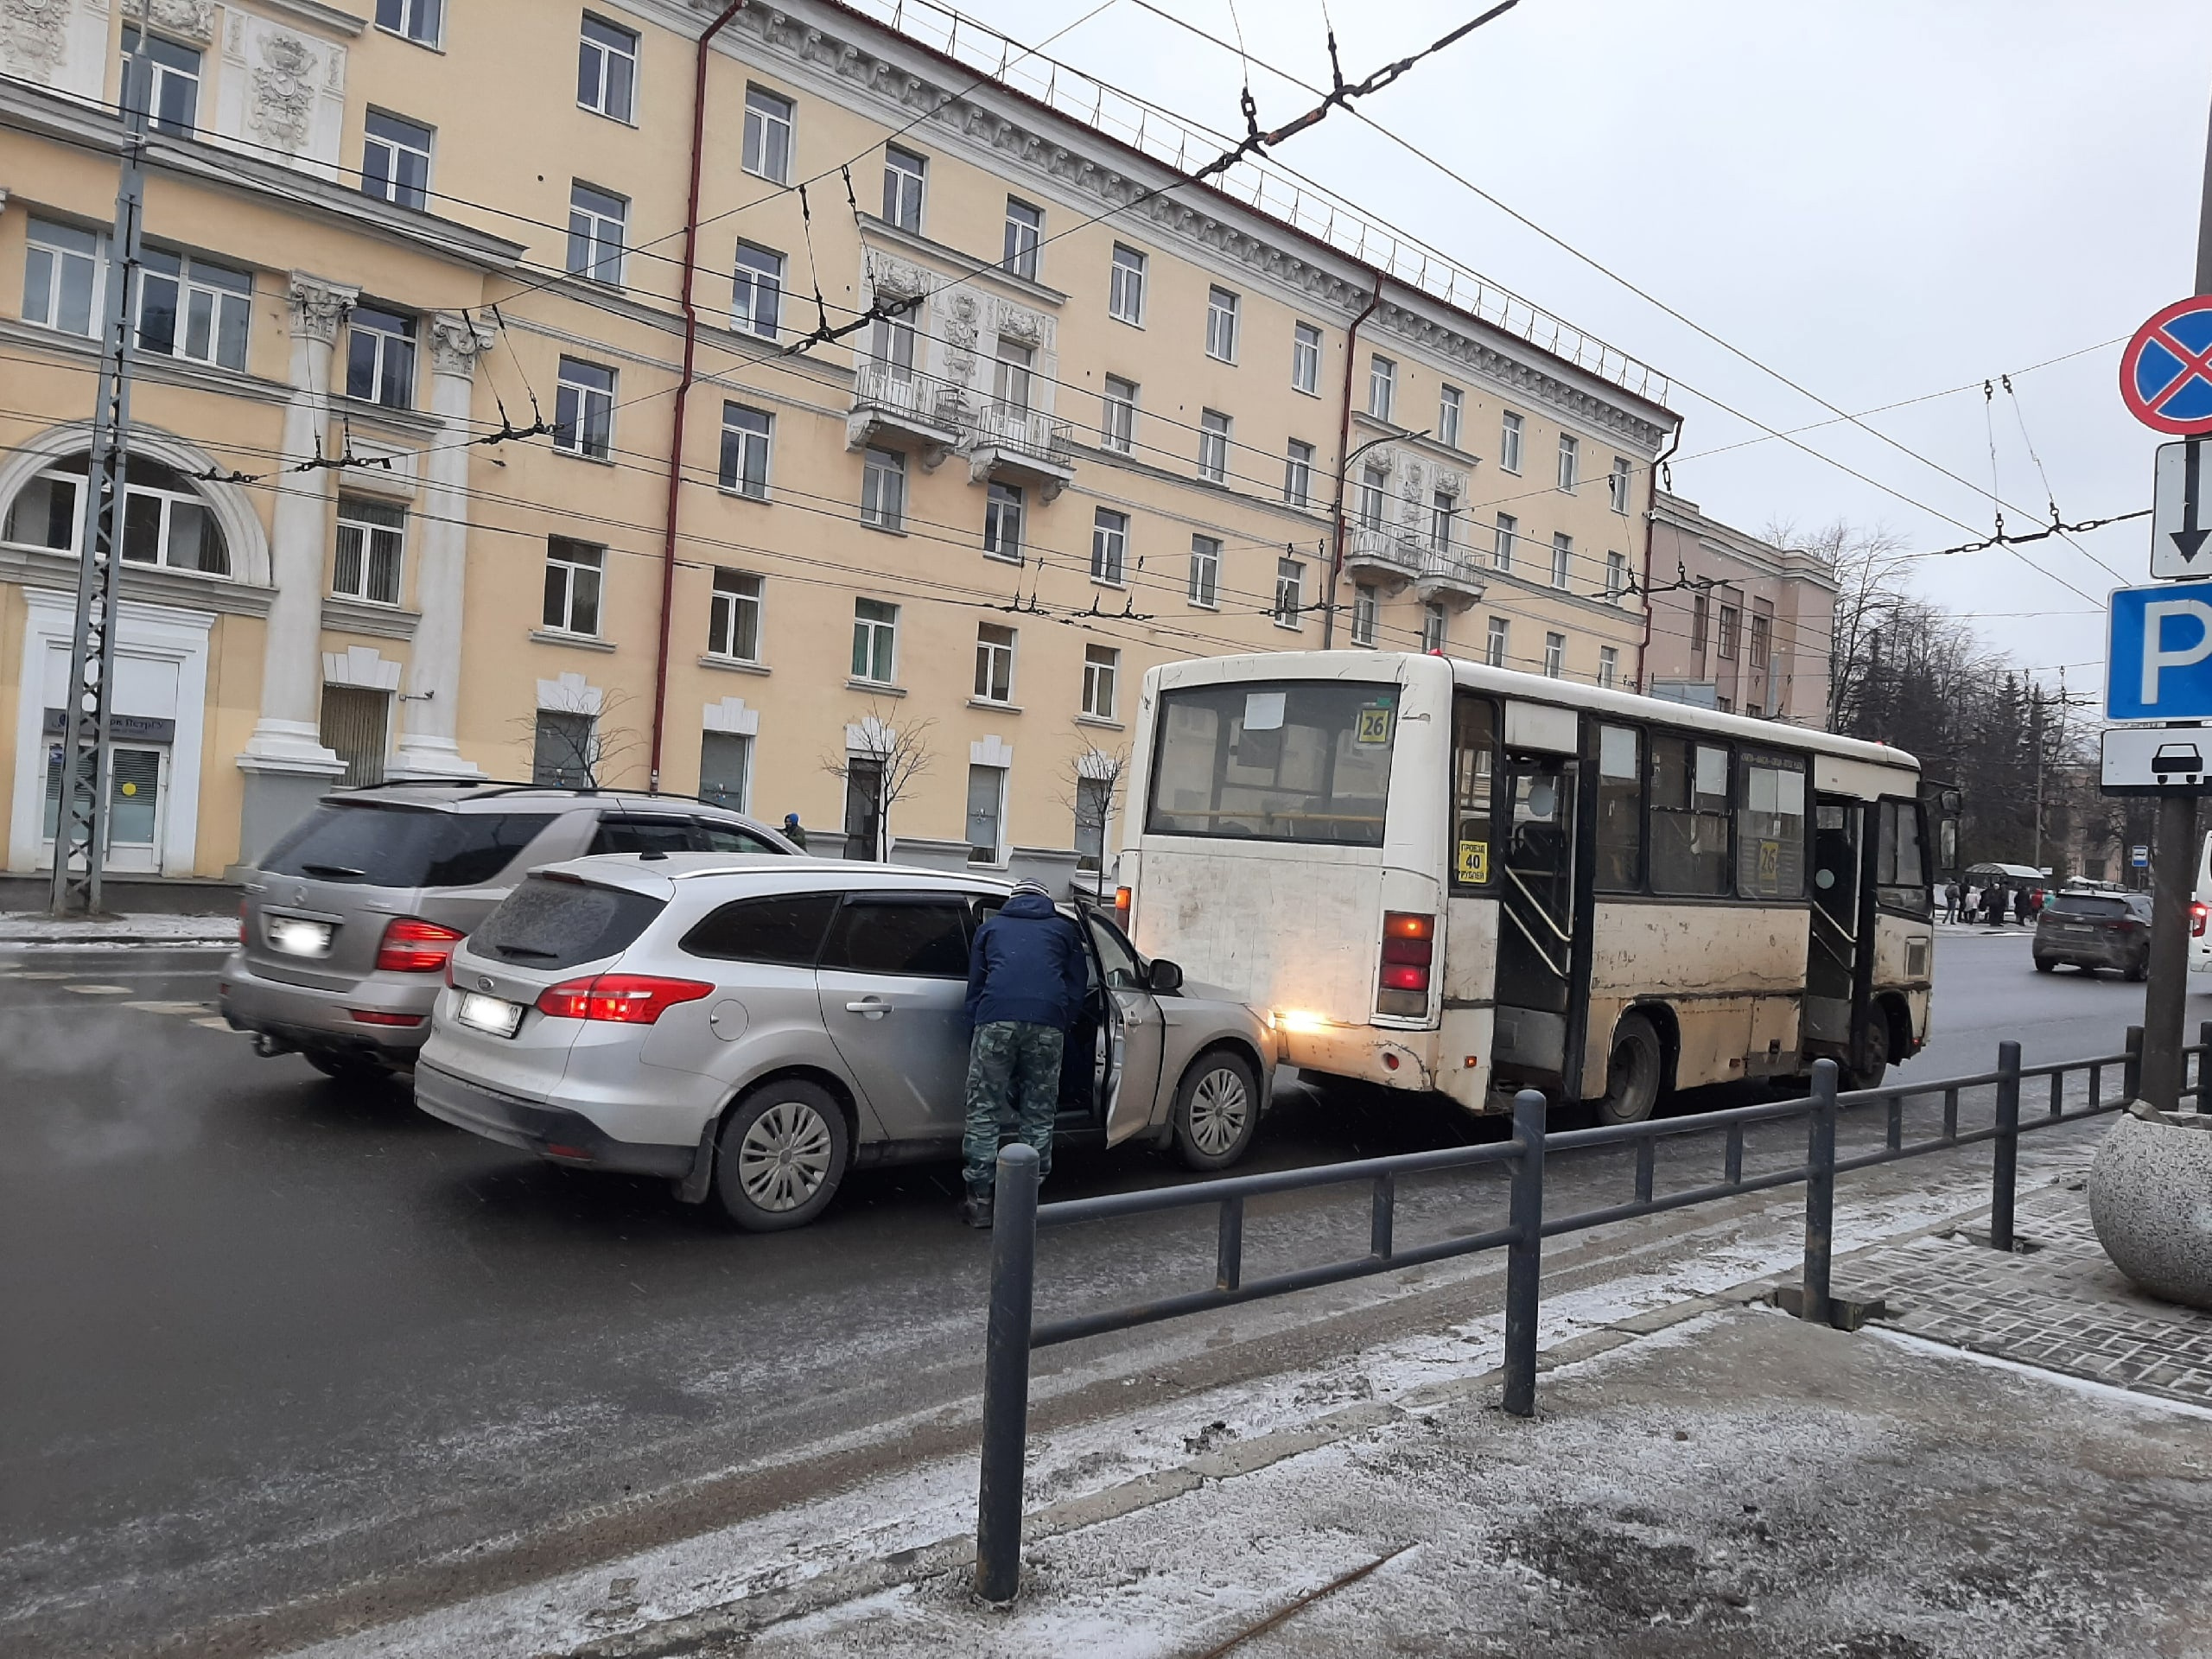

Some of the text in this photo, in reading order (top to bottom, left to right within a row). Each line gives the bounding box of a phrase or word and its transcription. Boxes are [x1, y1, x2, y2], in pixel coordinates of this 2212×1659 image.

[2141, 600, 2212, 705] P
[1363, 715, 1384, 736] 26
[1465, 855, 1480, 869] 40
